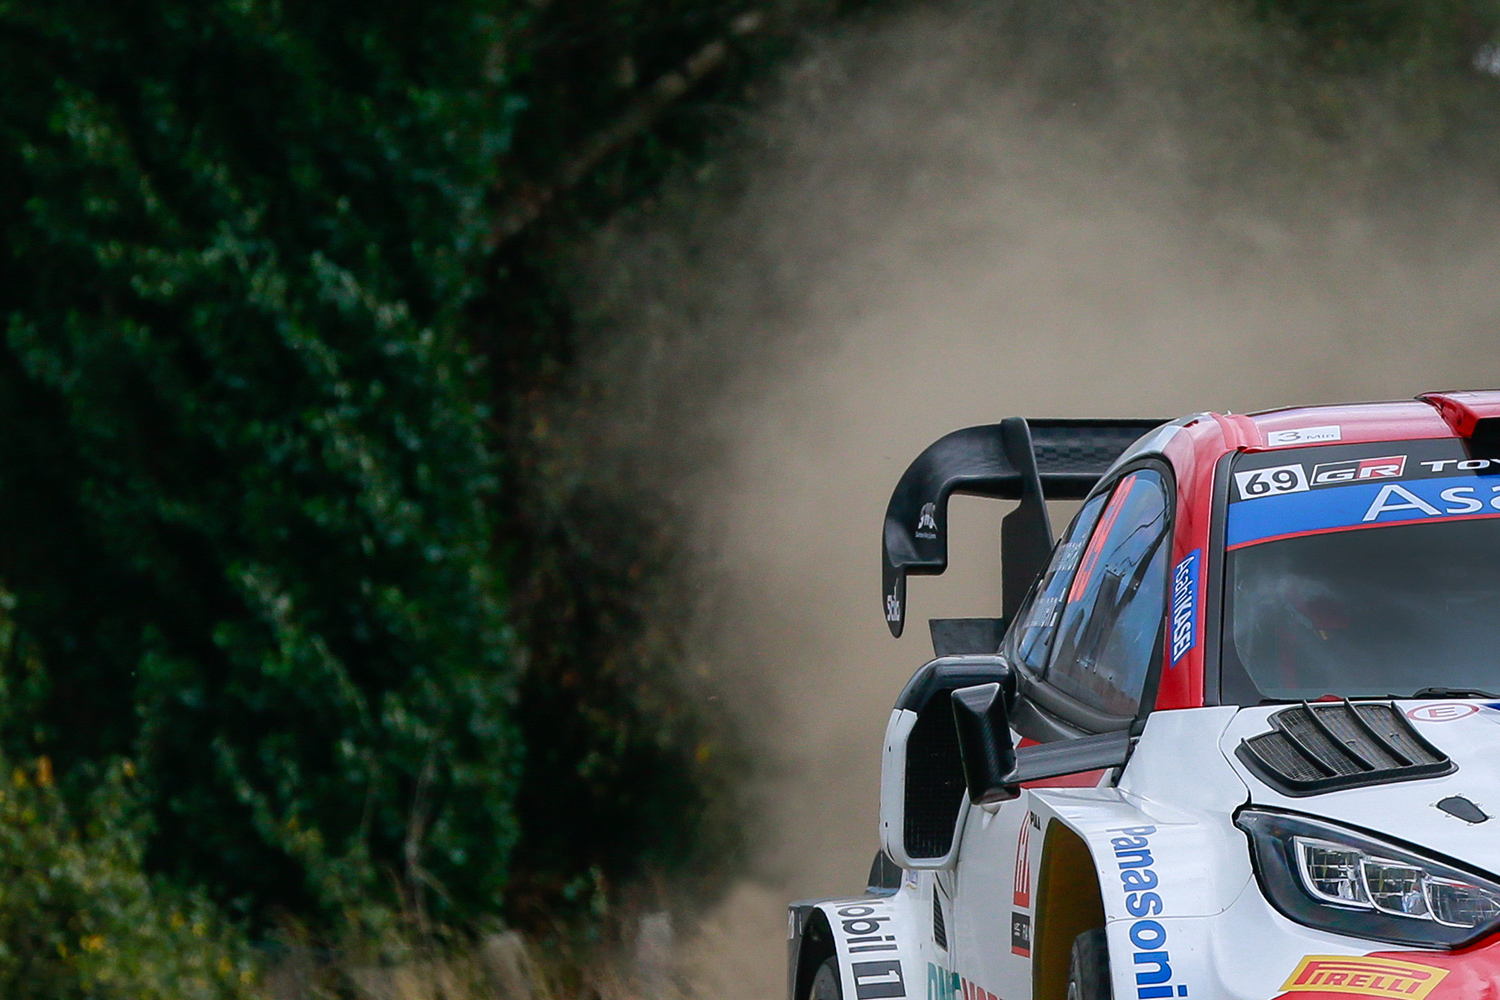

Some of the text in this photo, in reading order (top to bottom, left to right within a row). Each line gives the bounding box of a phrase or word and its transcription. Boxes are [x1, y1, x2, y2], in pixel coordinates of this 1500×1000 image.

[1278, 431, 1302, 445] 3
[1245, 471, 1298, 496] 69
[1316, 464, 1401, 483] GR
[835, 901, 898, 953] obil
[1294, 962, 1430, 995] PIRELLI
